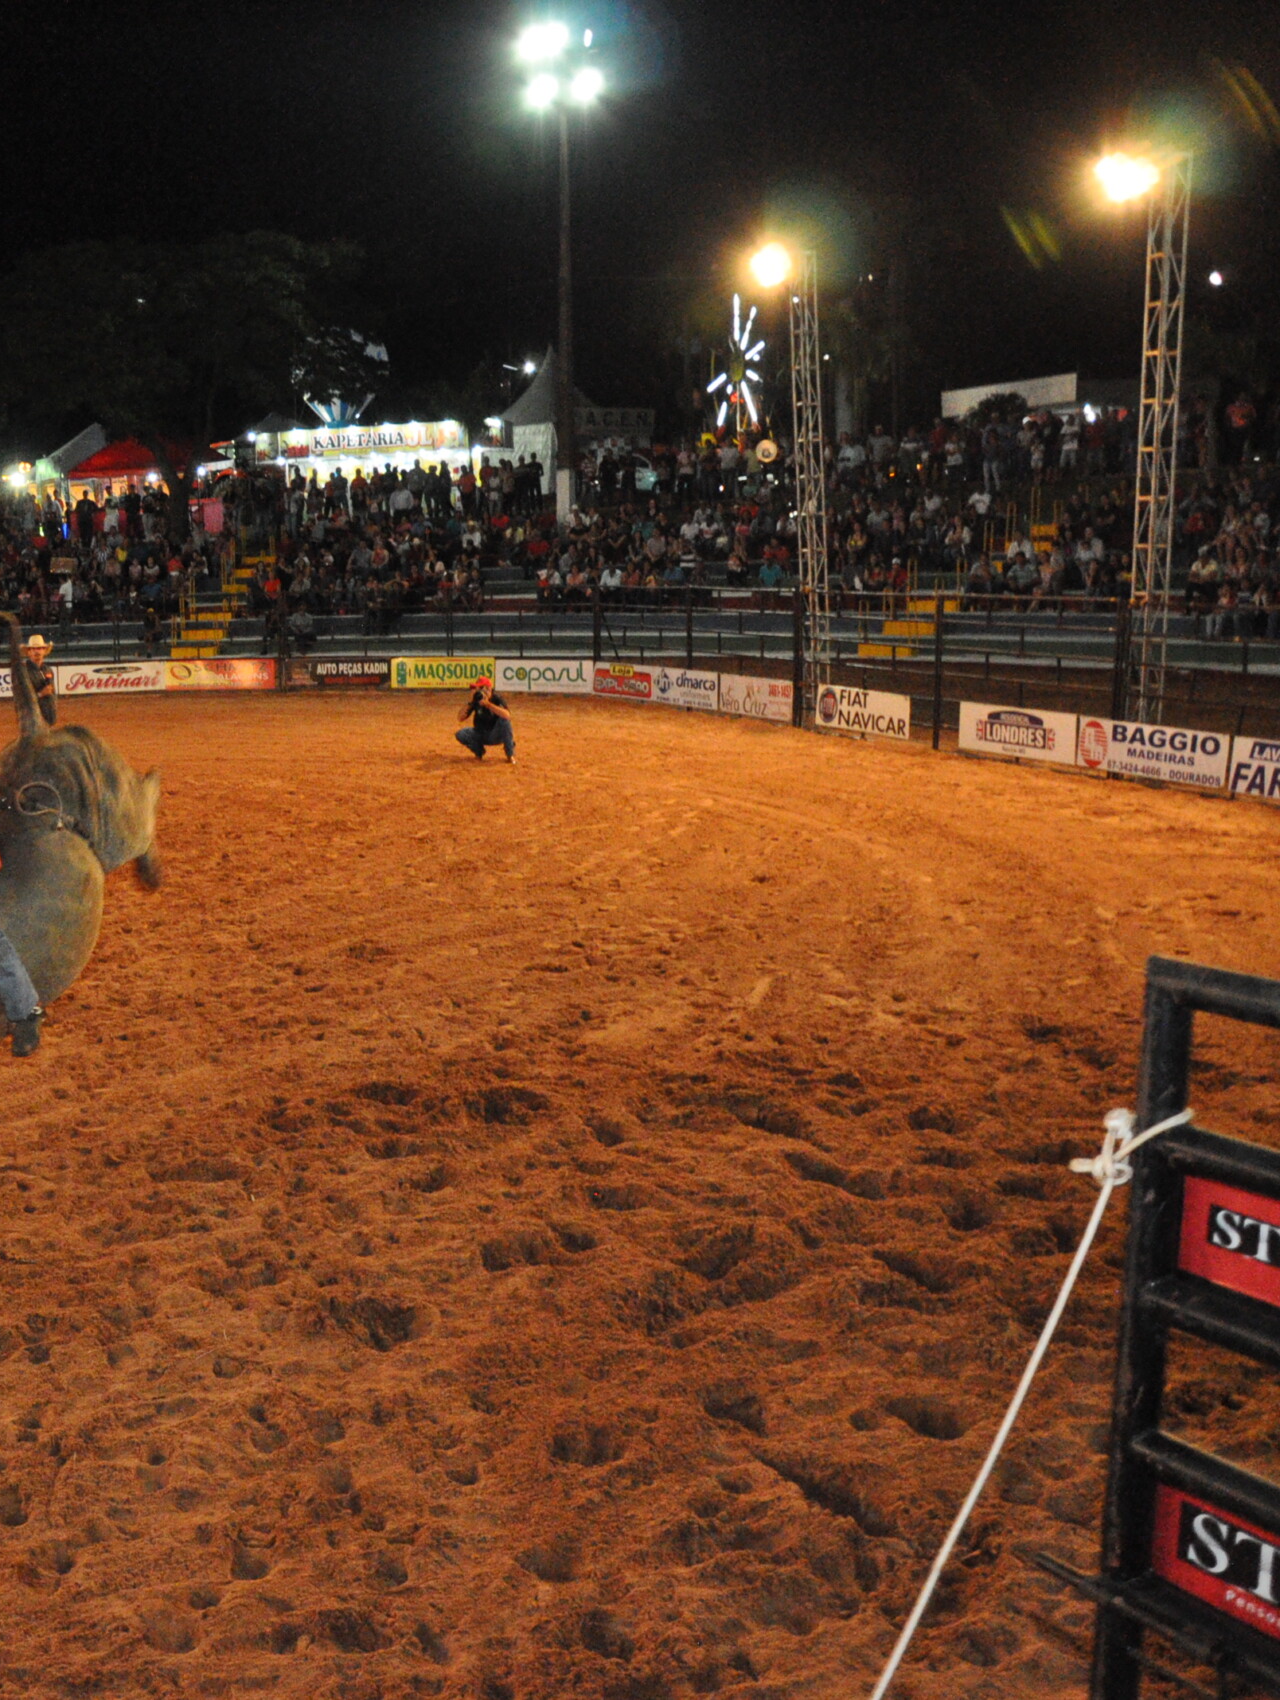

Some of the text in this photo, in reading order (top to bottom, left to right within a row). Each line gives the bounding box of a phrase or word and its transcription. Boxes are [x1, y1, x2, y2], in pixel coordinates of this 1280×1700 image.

[313, 431, 405, 449] KAPETARIA
[317, 662, 337, 675] AUTO
[339, 662, 362, 677] PEÇAS
[414, 663, 493, 681] MAQSOLDAS
[503, 661, 587, 690] copasul
[612, 665, 631, 676] Loja
[66, 671, 161, 691] Portinari
[743, 694, 768, 716] Cruz
[839, 689, 869, 709] FIAT
[838, 709, 906, 736] NAVICAR
[986, 724, 1045, 748] LONDRES
[1111, 724, 1221, 755] BAGGIO
[1127, 748, 1195, 766] MADEIRAS
[1169, 769, 1221, 786] DOURADOS
